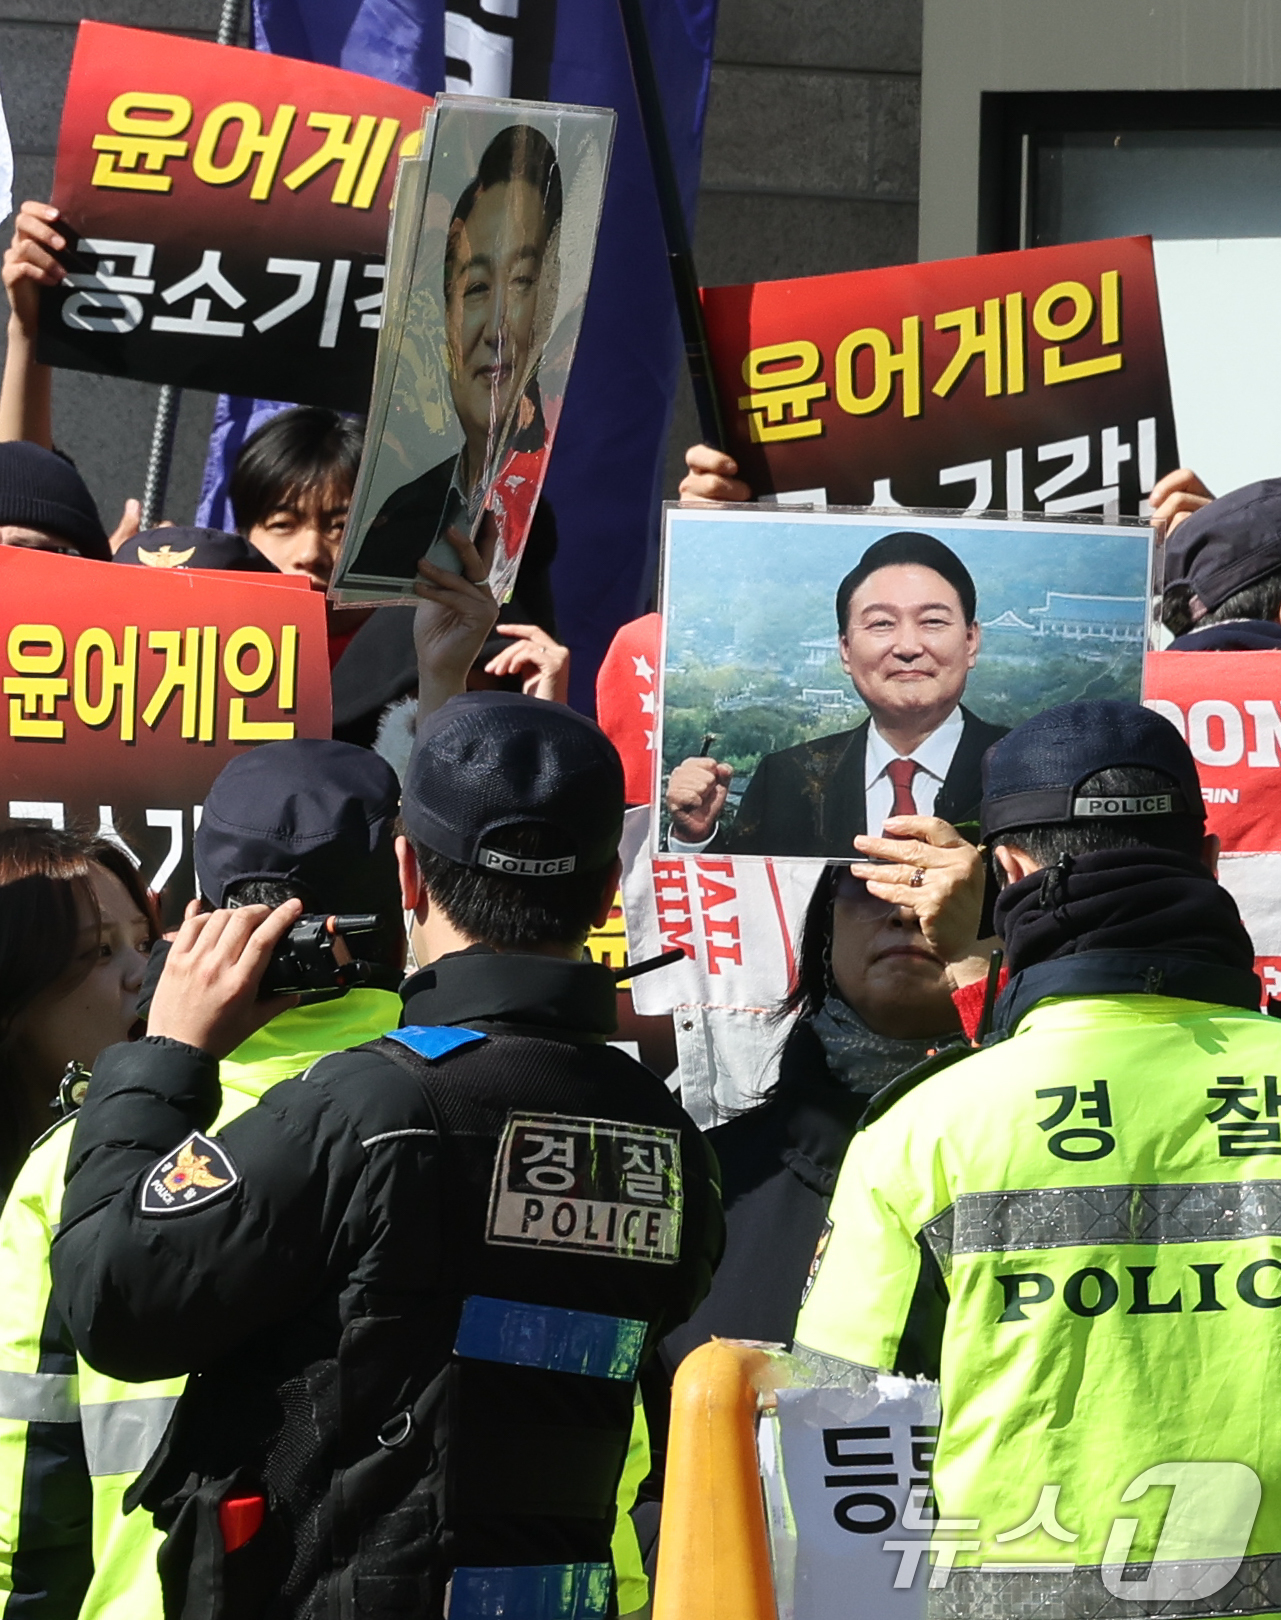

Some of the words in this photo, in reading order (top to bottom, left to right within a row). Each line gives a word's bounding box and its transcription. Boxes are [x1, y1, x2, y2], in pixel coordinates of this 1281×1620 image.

[91, 92, 422, 210] 윤어게
[738, 270, 1122, 443] 윤어게인
[3, 623, 297, 741] 윤어게인
[1089, 797, 1168, 814] POLICE
[488, 853, 571, 874] POLICE
[652, 856, 696, 960] HIM
[521, 1198, 662, 1247] POLICE
